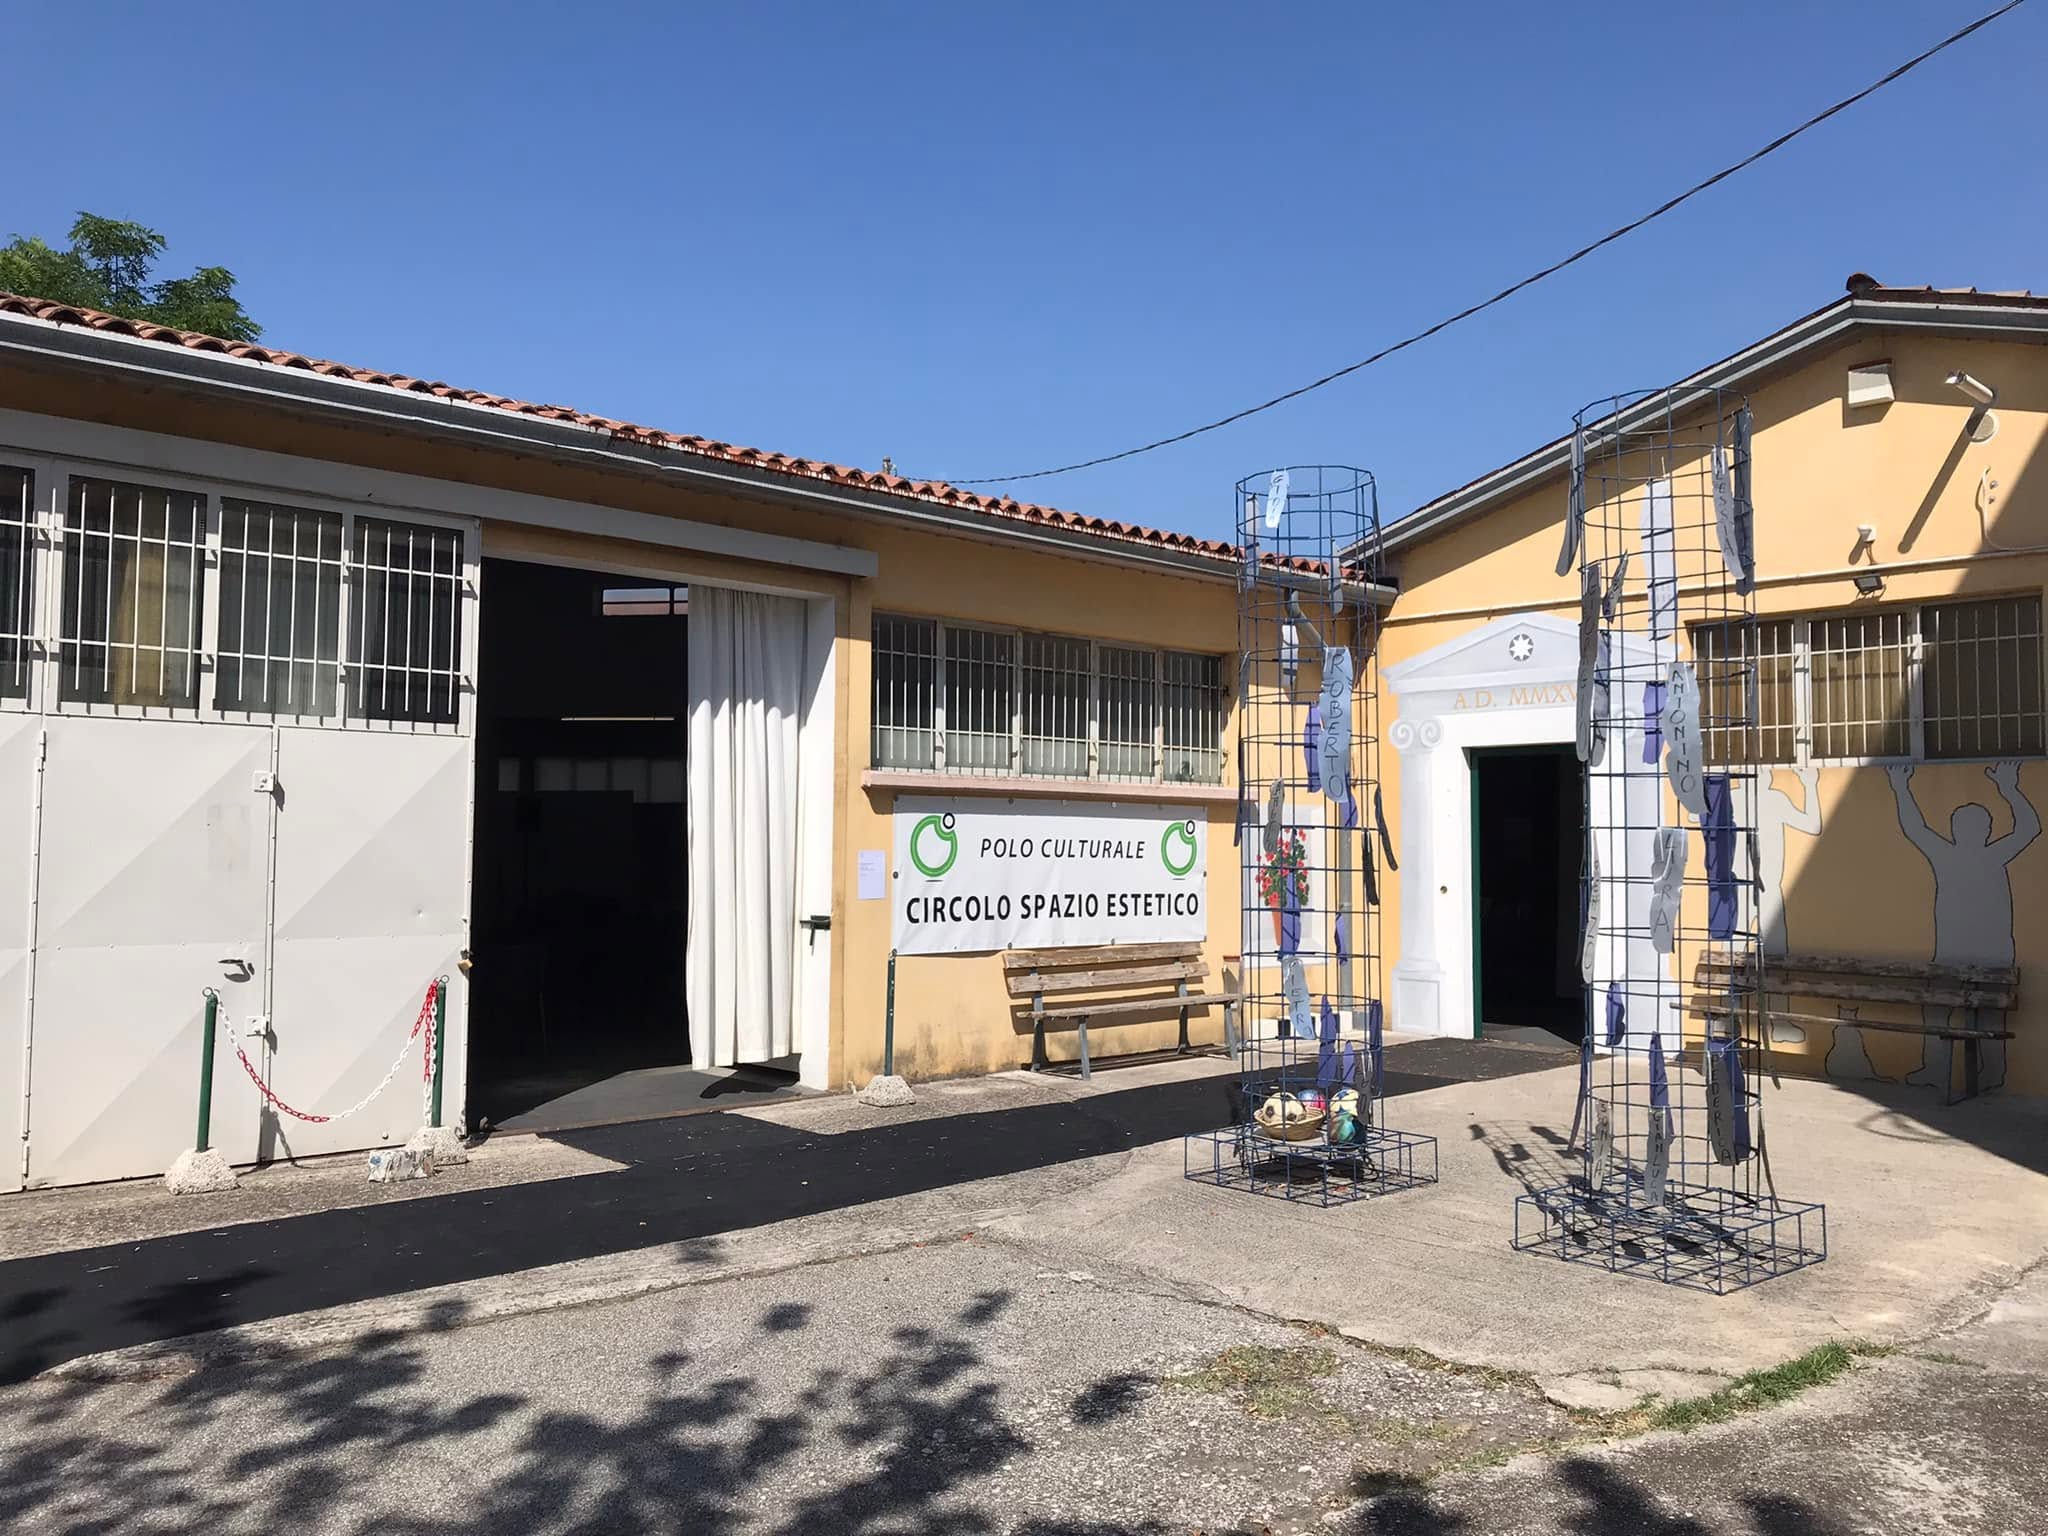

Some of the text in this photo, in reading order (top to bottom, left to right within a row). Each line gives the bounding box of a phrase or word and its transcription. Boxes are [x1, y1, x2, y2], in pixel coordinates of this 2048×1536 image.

[1323, 653, 1345, 799] ROBERTO
[980, 838, 1146, 859] POLO CULTURALE
[906, 892, 1199, 924] CIRCOLO SPAZIO ESTETICO
[1711, 1053, 1733, 1162] FEDERICA
